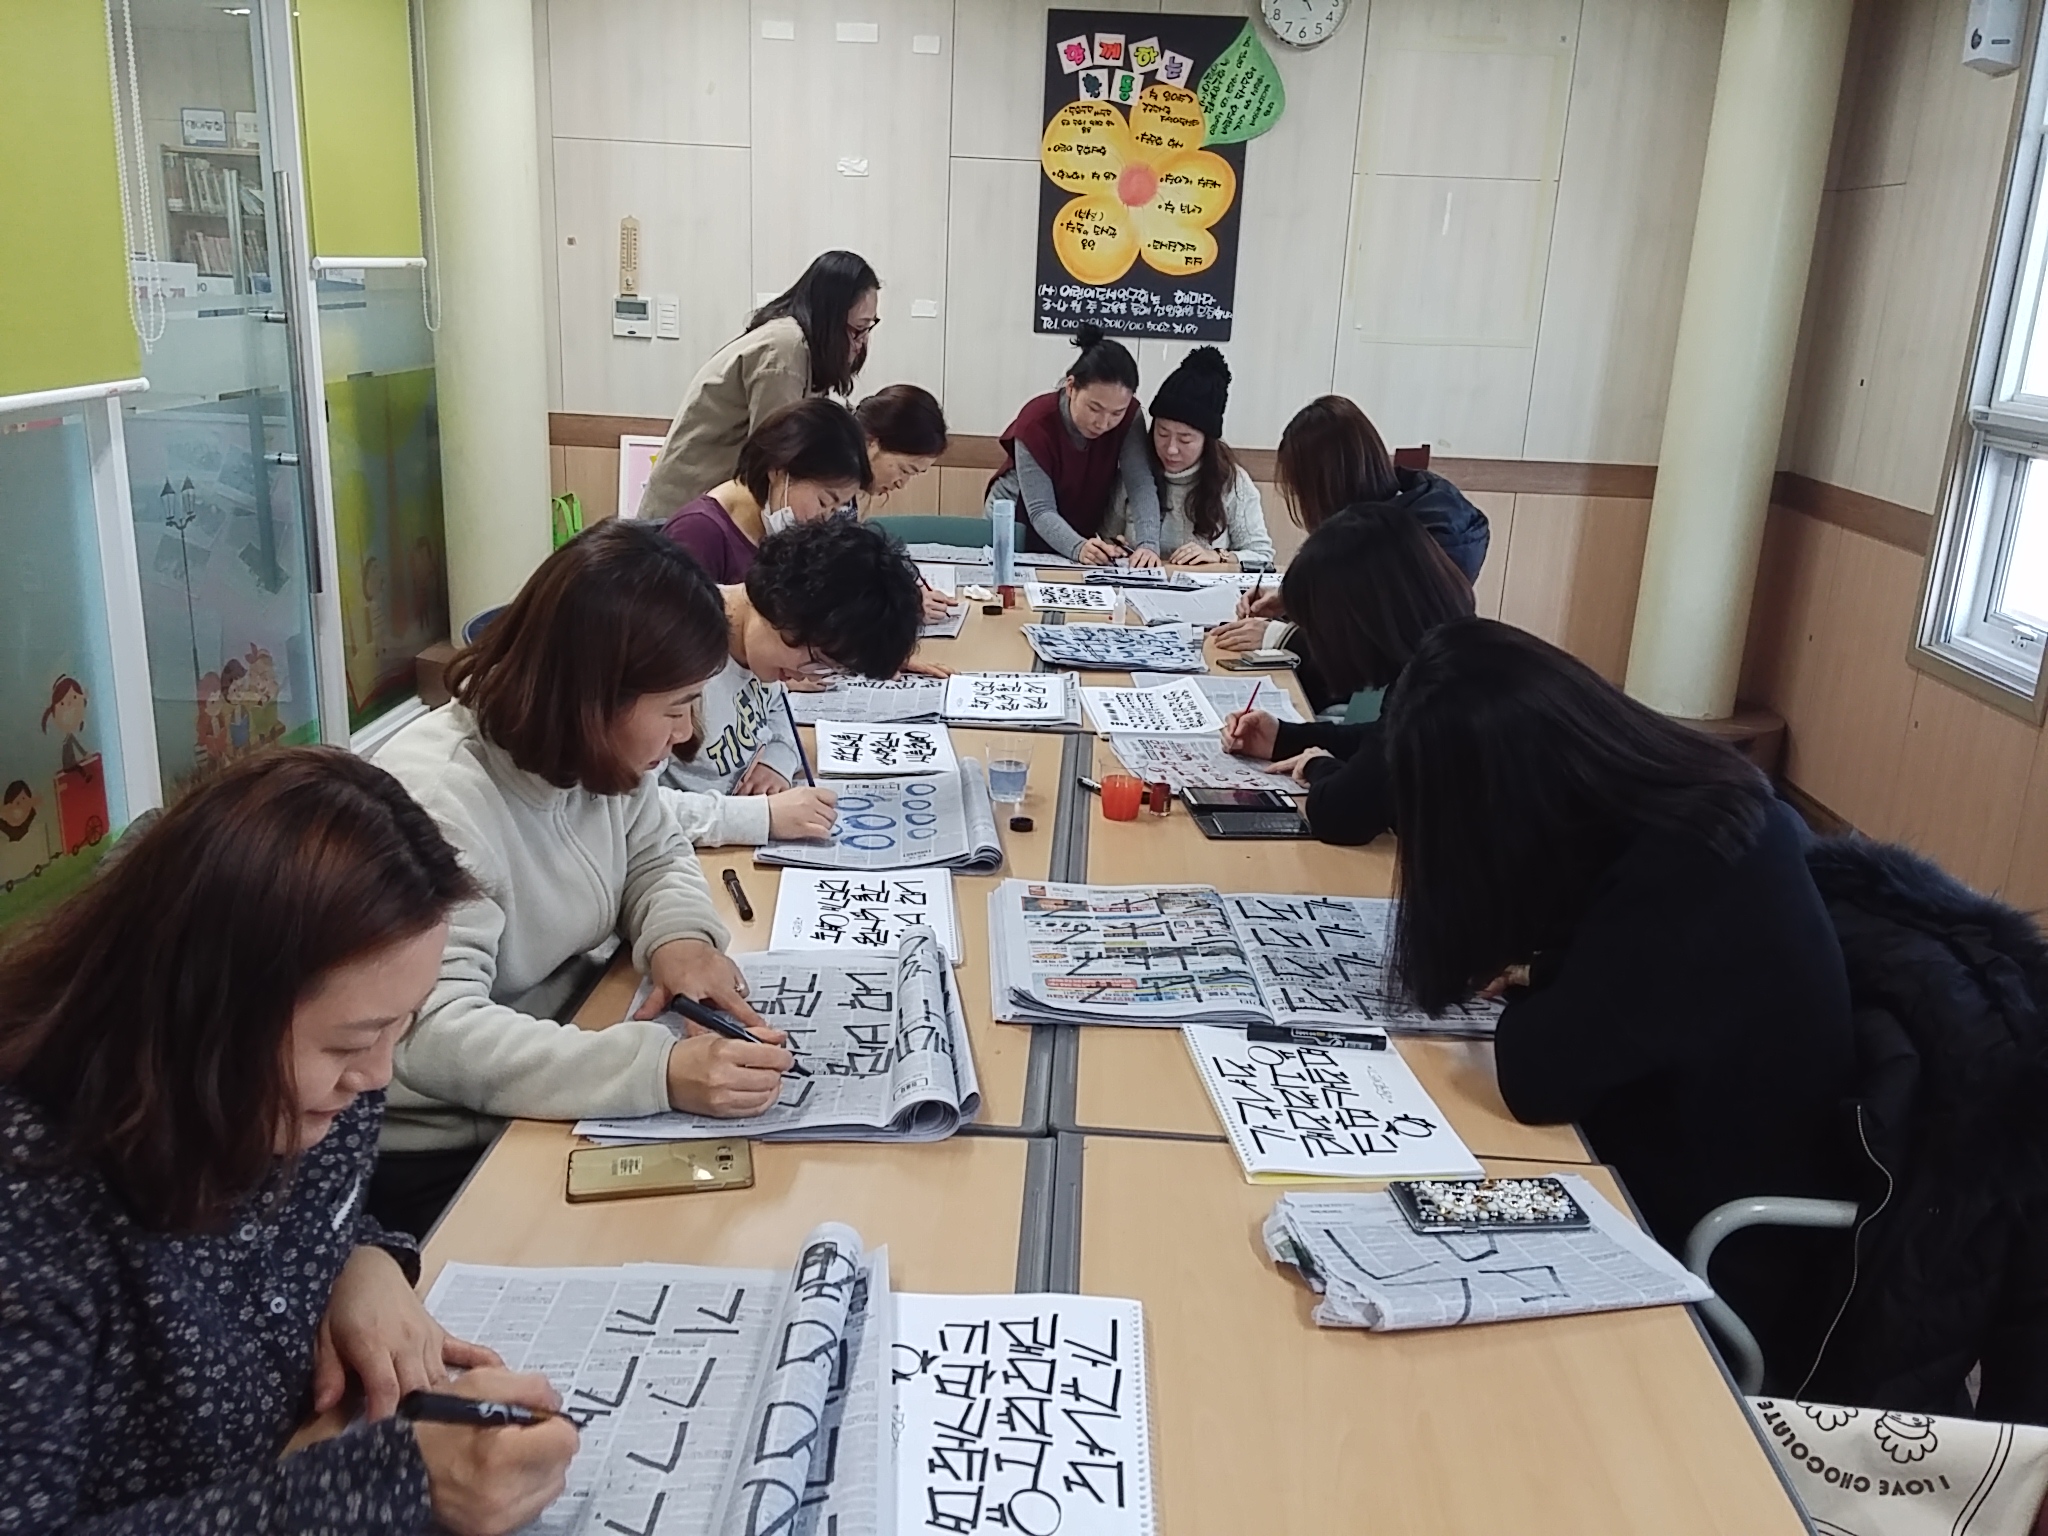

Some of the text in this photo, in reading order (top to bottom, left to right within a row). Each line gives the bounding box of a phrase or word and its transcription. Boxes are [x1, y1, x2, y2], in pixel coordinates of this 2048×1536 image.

[1273, 8, 1281, 20] 8
[1325, 11, 1333, 22] 4
[1285, 21, 1293, 33] 7
[1298, 27, 1307, 38] 6
[1315, 23, 1322, 35] 5
[1756, 1399, 1951, 1496] I LOVE CHOCOLATE
